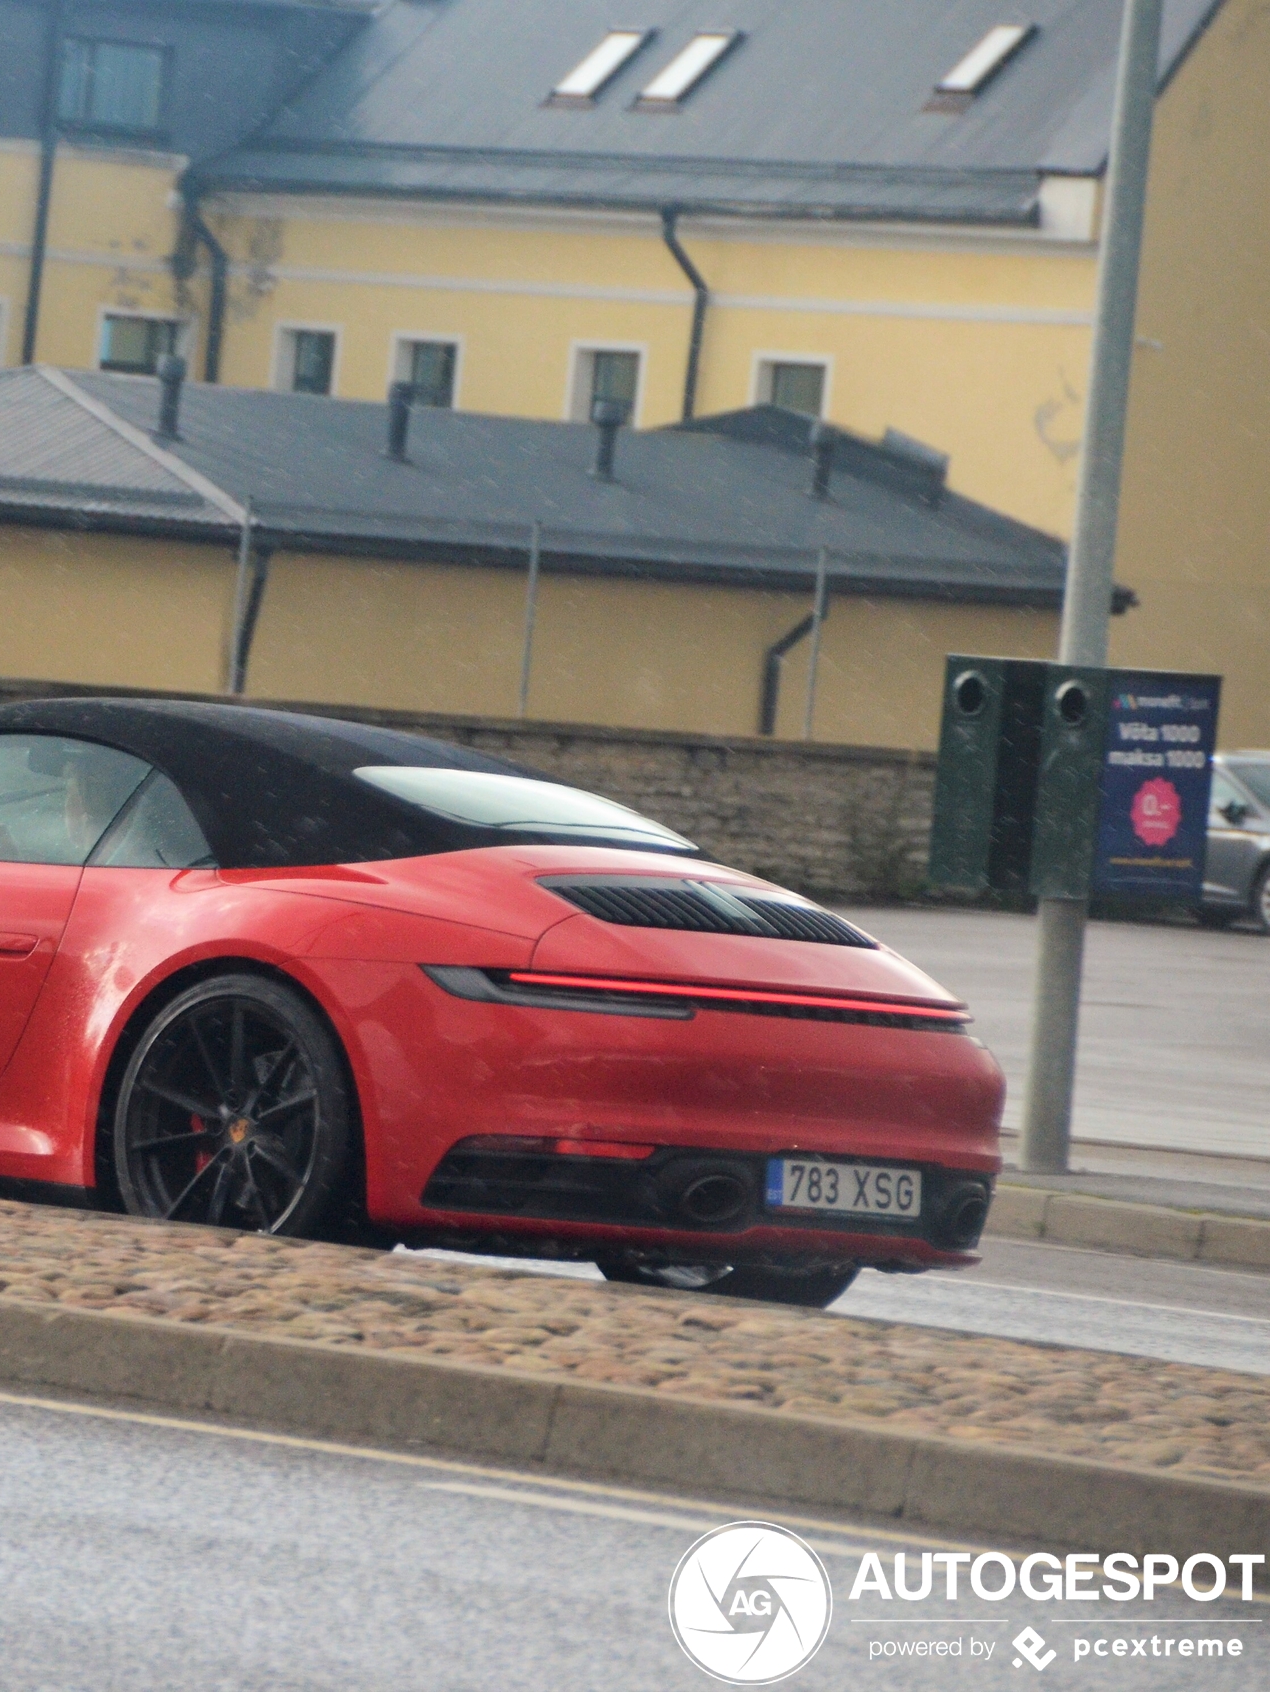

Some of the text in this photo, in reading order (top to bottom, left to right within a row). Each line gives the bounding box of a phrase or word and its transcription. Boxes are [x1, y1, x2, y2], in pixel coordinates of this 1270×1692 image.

[1161, 724, 1200, 743] 1000
[1108, 748, 1205, 769] maksa 1000
[790, 1164, 914, 1210] 783 XSG
